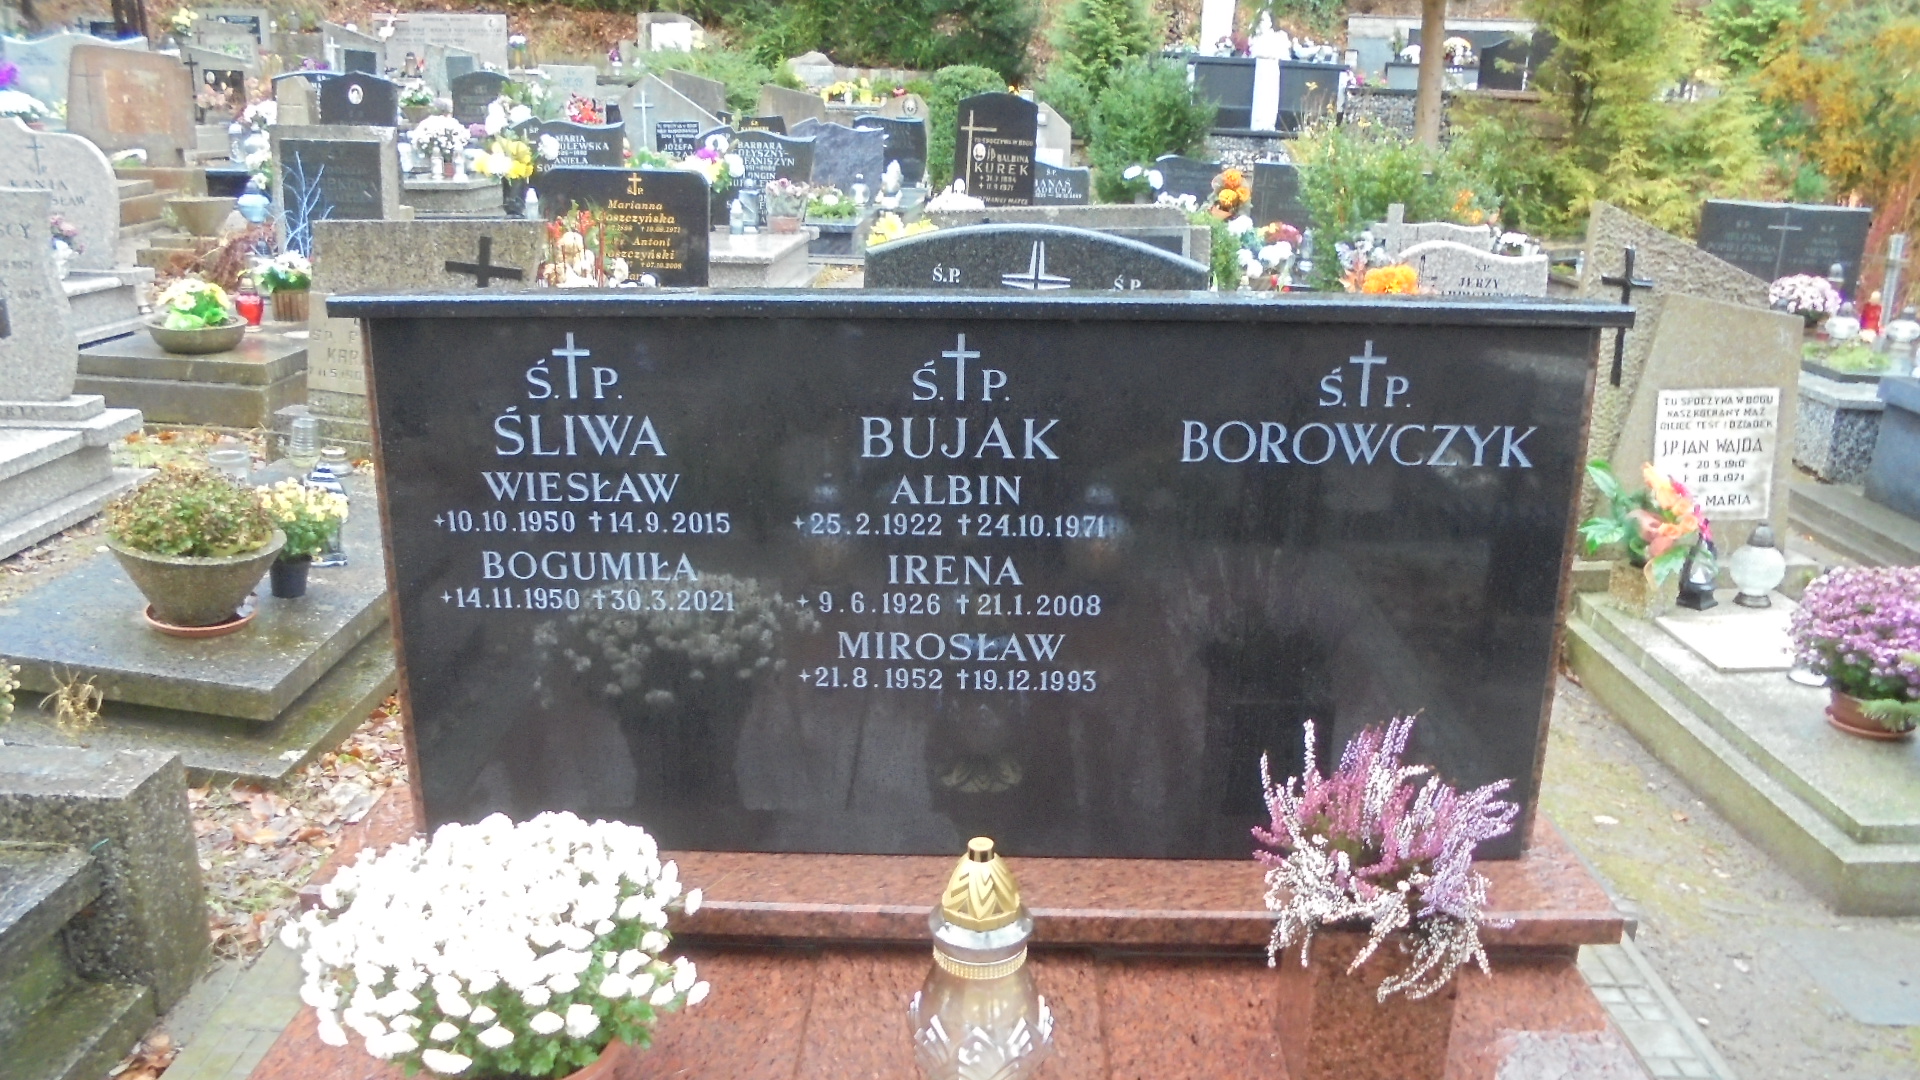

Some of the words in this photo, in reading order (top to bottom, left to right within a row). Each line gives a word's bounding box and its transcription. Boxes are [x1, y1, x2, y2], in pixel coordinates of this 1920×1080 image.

[737, 141, 783, 150] BARBARA
[974, 162, 1028, 176] KUREK
[607, 199, 663, 210] Marianna
[632, 236, 671, 247] Antoni
[932, 263, 961, 283] Ś.P.
[1459, 277, 1499, 289] JERZY
[494, 405, 667, 456] ŚLIWA
[860, 416, 1060, 460] BUJAK
[1180, 420, 1538, 468] BOROWCZYK
[1682, 439, 1710, 456] JAN
[1716, 437, 1763, 455] WAJDA
[481, 471, 680, 503] WIESŁAW
[890, 475, 1021, 505] ALBIN
[1705, 494, 1752, 507] MARIA
[482, 551, 699, 581] BOGUMIŁA
[888, 555, 1023, 586] IRENA
[837, 631, 1065, 661] MIROSŁAW
